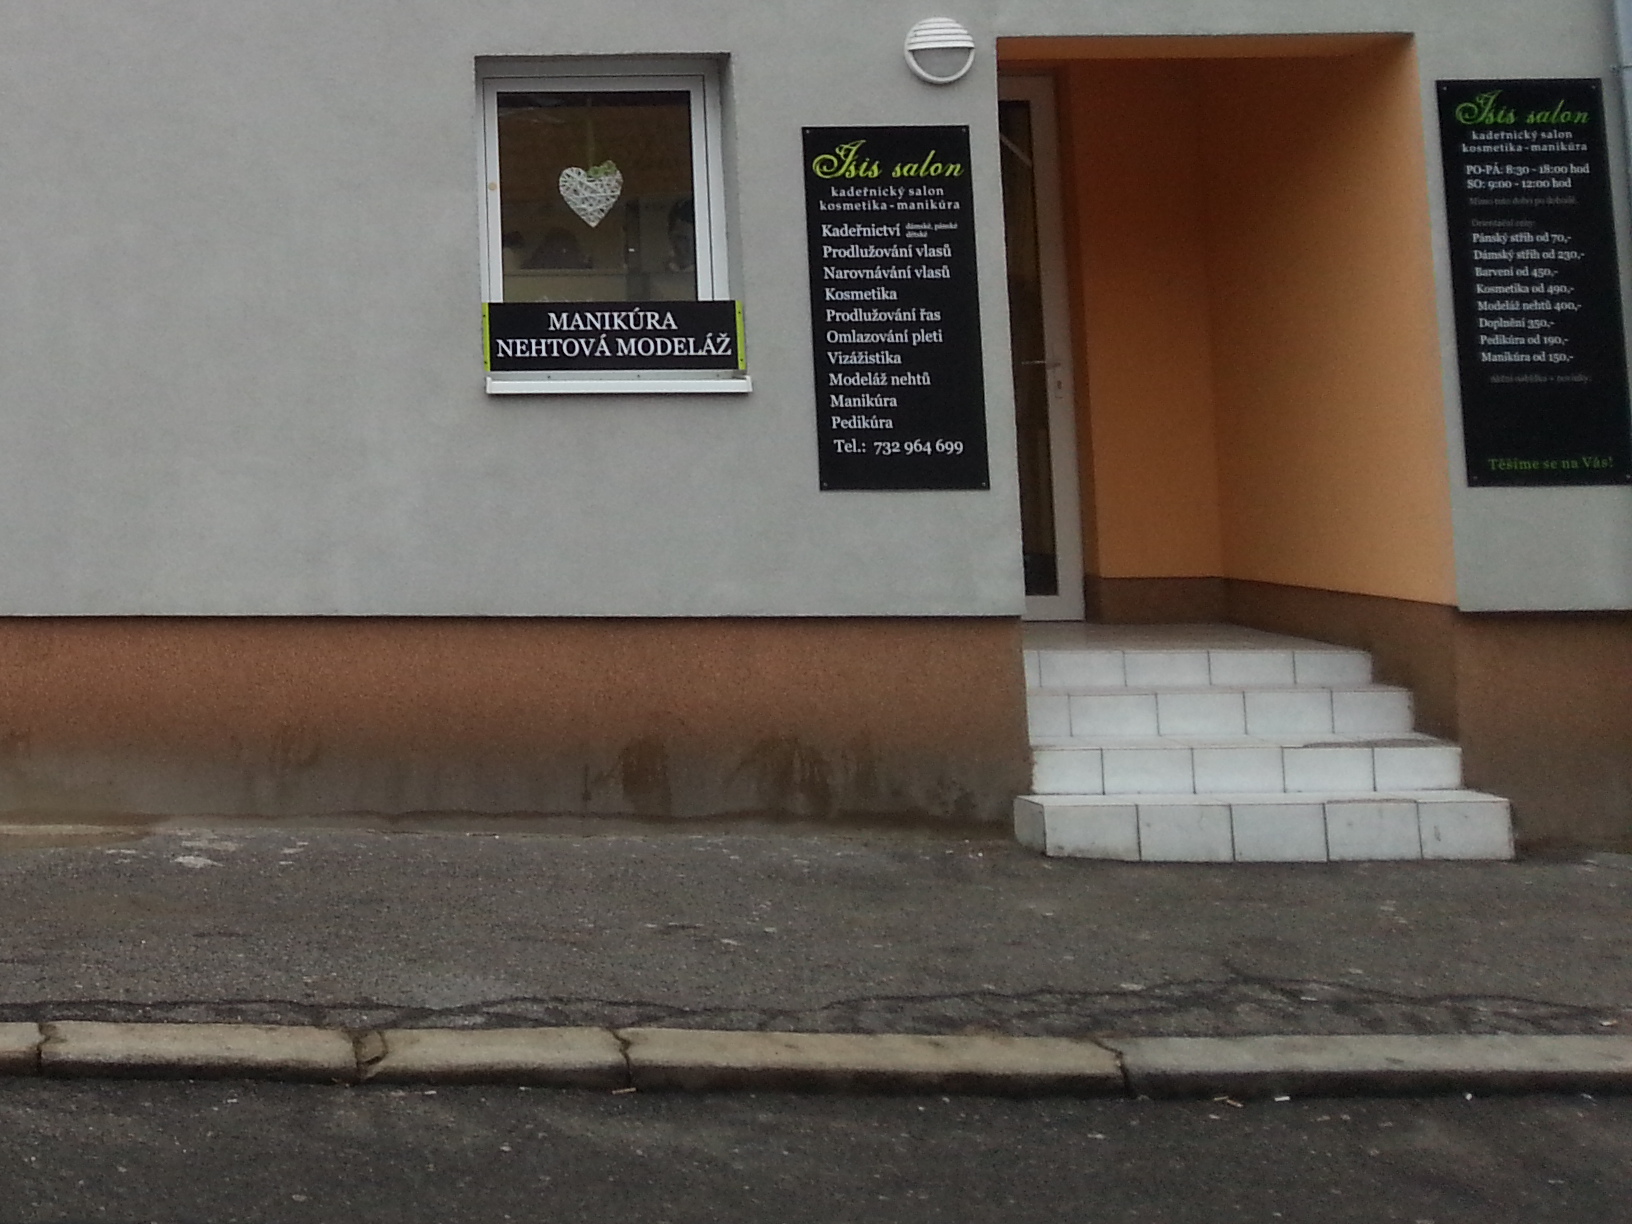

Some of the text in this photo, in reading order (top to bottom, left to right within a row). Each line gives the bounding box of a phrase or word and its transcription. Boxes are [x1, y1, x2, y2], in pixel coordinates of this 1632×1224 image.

[1526, 99, 1590, 125] salon
[1540, 129, 1573, 139] salon
[1462, 143, 1523, 153] kosmetika
[1530, 141, 1588, 152] manikúra
[891, 149, 964, 178] salon
[1466, 162, 1503, 175] PO-PÁ:
[1505, 164, 1530, 176] 8:30
[1539, 164, 1568, 174] 18:00
[1569, 163, 1590, 174] hod
[1467, 179, 1486, 189] SO:
[1487, 179, 1512, 190] 9:00
[1521, 179, 1551, 188] 12:00
[1552, 177, 1572, 188] hod
[830, 185, 945, 200] kadeřnický salon
[819, 199, 888, 211] kosmetika
[896, 199, 961, 210] manikúra
[821, 223, 901, 238] Kadeřnictví
[1472, 231, 1572, 245] Pánský střih od 70,-
[822, 243, 952, 259] Prodlužování vlasů
[1473, 249, 1514, 262] Dámský
[1516, 249, 1540, 260] střih
[1542, 248, 1555, 259] od
[823, 264, 951, 280] Narovnávání vlasů
[1515, 266, 1529, 276] od
[1531, 268, 1559, 278] 450,-
[824, 287, 898, 301] Kosmetika
[1476, 283, 1575, 295] Kosmetika od 490,-
[1554, 302, 1582, 312] 400,-
[548, 306, 678, 332] MANIKÚRA
[825, 308, 941, 323] Prodlužování řas
[826, 329, 944, 346] Omlazování pleti
[1480, 334, 1525, 345] Pedikúra
[1527, 334, 1541, 345] od
[496, 332, 732, 358] NEHTOVÁ MODELÁŽ
[827, 351, 902, 365] Vizážistika
[1481, 351, 1531, 362] Manikúra
[1533, 351, 1546, 362] od
[828, 371, 931, 387] Modeláž nehtů
[830, 393, 898, 408] Manikúra
[831, 415, 894, 430] Pedikúra
[833, 439, 964, 455] Tel.: 732 964 699
[1543, 460, 1557, 469] se
[1562, 459, 1578, 469] na
